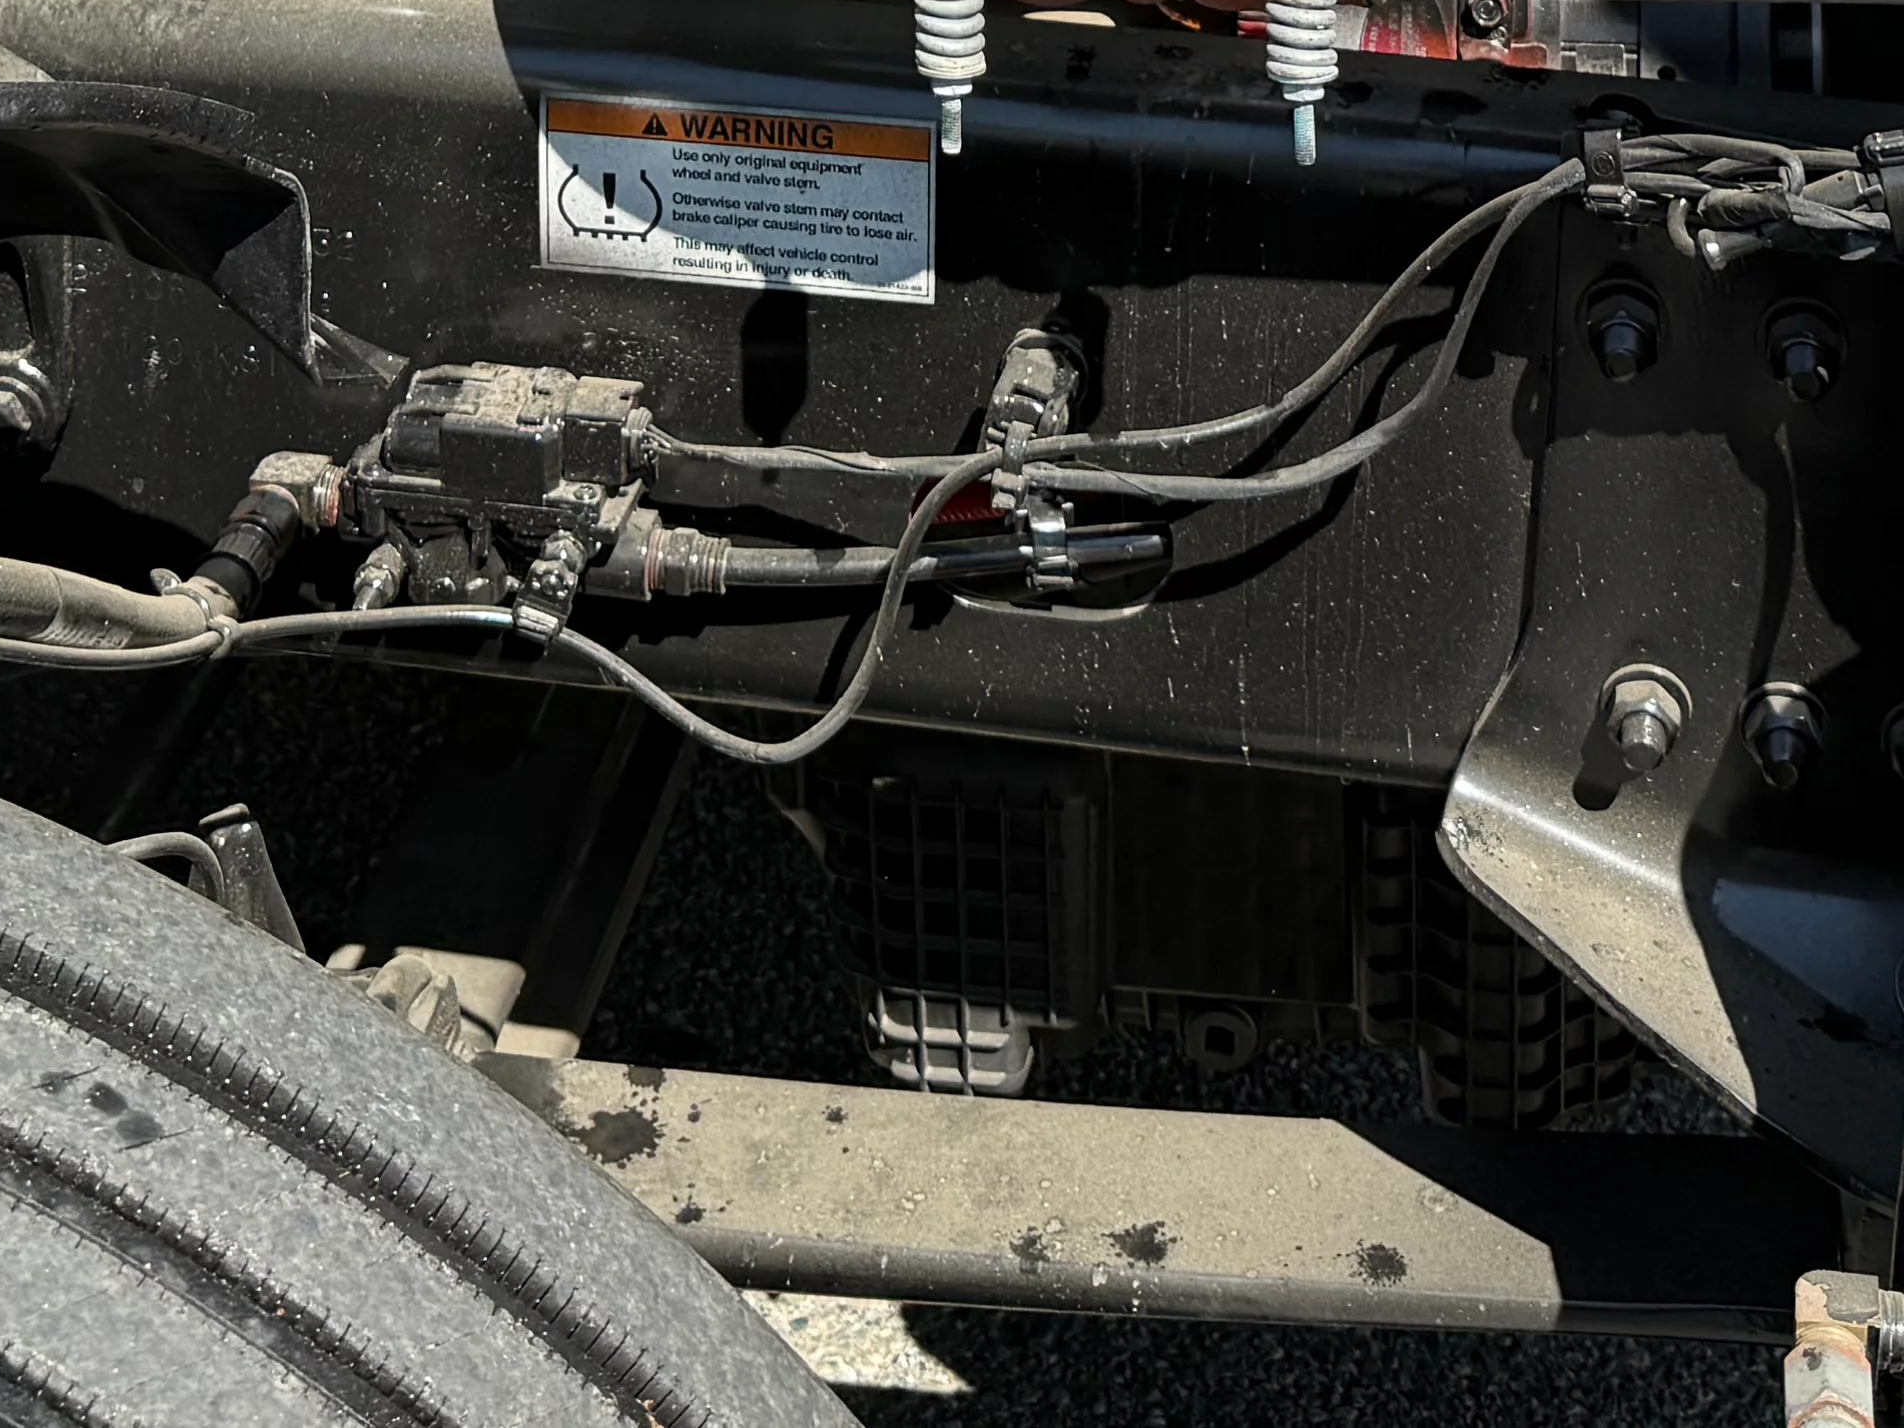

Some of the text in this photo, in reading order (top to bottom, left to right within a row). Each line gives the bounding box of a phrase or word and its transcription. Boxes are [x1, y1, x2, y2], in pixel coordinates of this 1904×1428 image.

[679, 113, 835, 150] WARNING
[672, 147, 863, 176] Use only original equipment
[672, 167, 821, 191] wheel and valve stem.
[672, 191, 904, 224] Otherwise valve stem may contact
[672, 209, 918, 243] brake caliper causing tire to lose air.
[673, 236, 879, 266] This may affect vehicle control
[672, 254, 855, 282] resulting in injury or death.
